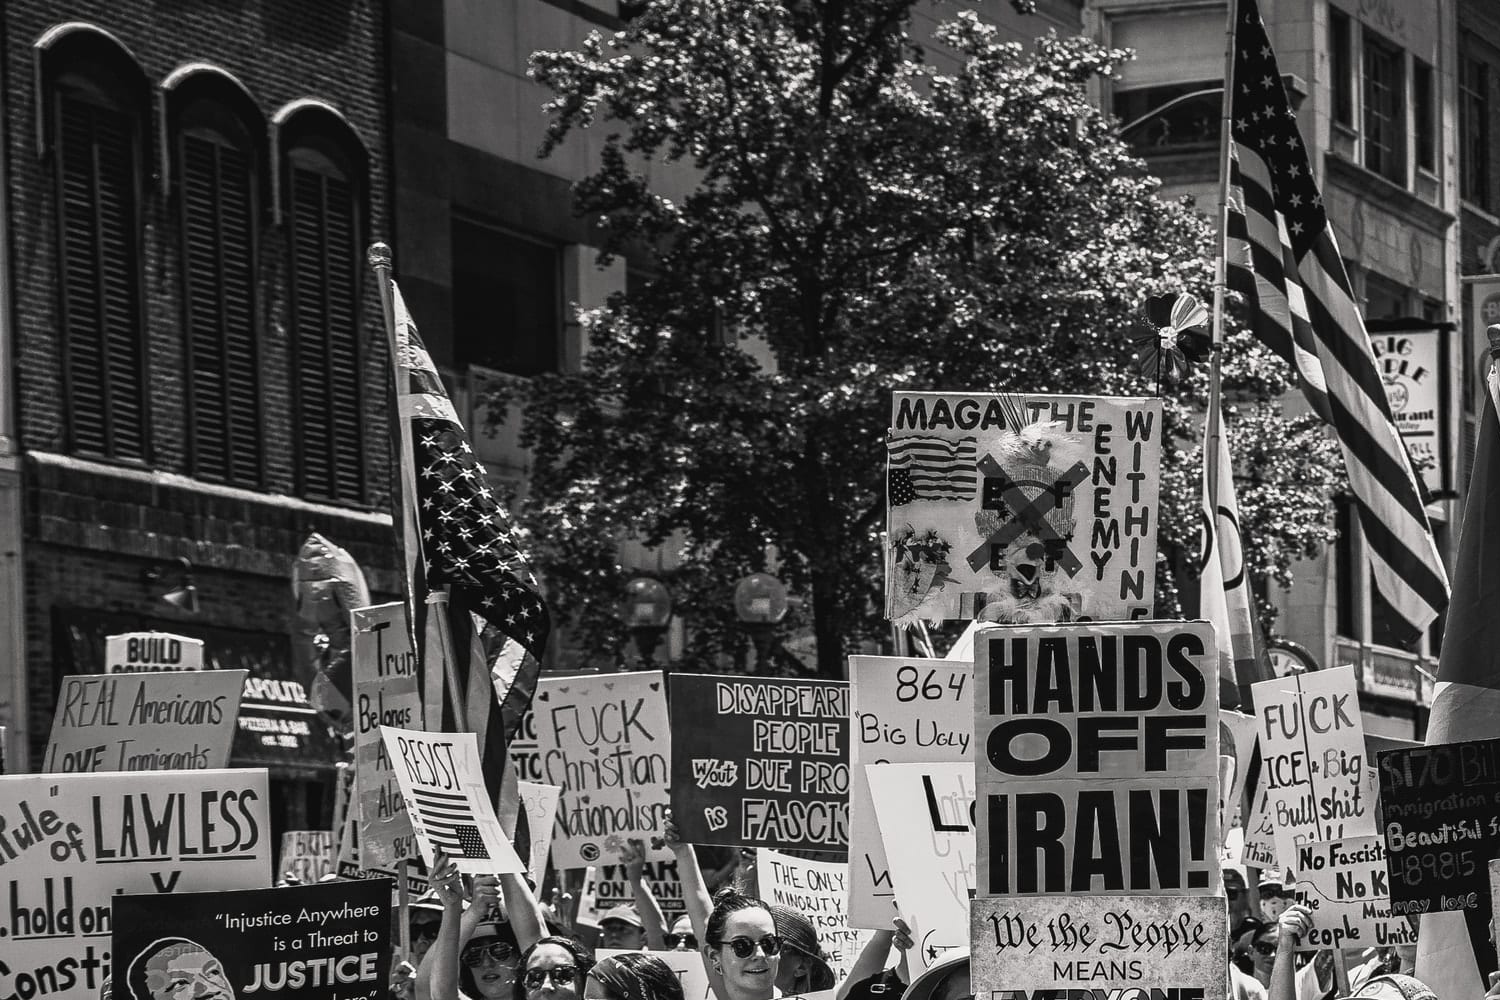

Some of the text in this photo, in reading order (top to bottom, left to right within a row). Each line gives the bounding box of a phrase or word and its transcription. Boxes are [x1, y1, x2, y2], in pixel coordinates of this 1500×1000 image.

[896, 398, 1095, 432] MAGA THE
[1091, 424, 1120, 581] ENEMY
[1120, 411, 1153, 600] WITHIN
[126, 637, 181, 664] BUILD
[988, 632, 1206, 716] HANDS
[61, 679, 227, 728] REAL Americans
[1263, 694, 1356, 740] FUCK
[552, 698, 654, 748] FUCK
[753, 720, 840, 755] PEOPLE
[986, 715, 1207, 777] OFF
[397, 736, 461, 792] RESIST
[545, 749, 668, 798] Christian
[745, 758, 792, 793] DUE
[1323, 749, 1362, 785] Big
[1382, 748, 1451, 800] $170
[703, 806, 728, 832] is
[1384, 792, 1487, 820] immigration
[50, 822, 87, 862] of
[92, 789, 260, 859] LAWLESS
[988, 788, 1210, 895] IRAN!
[1386, 819, 1482, 853] Beautiful
[770, 861, 845, 892] THE ONLY
[1299, 848, 1325, 871] No
[598, 882, 625, 898] ON
[773, 887, 842, 914] MINORITY
[1336, 871, 1367, 900] No
[296, 902, 380, 926] Anywhere
[1392, 898, 1431, 915] may
[274, 929, 379, 951] is a Threat to
[987, 910, 1210, 959] We the People
[242, 952, 379, 994] JUSTICE
[1053, 960, 1143, 981] MEANS
